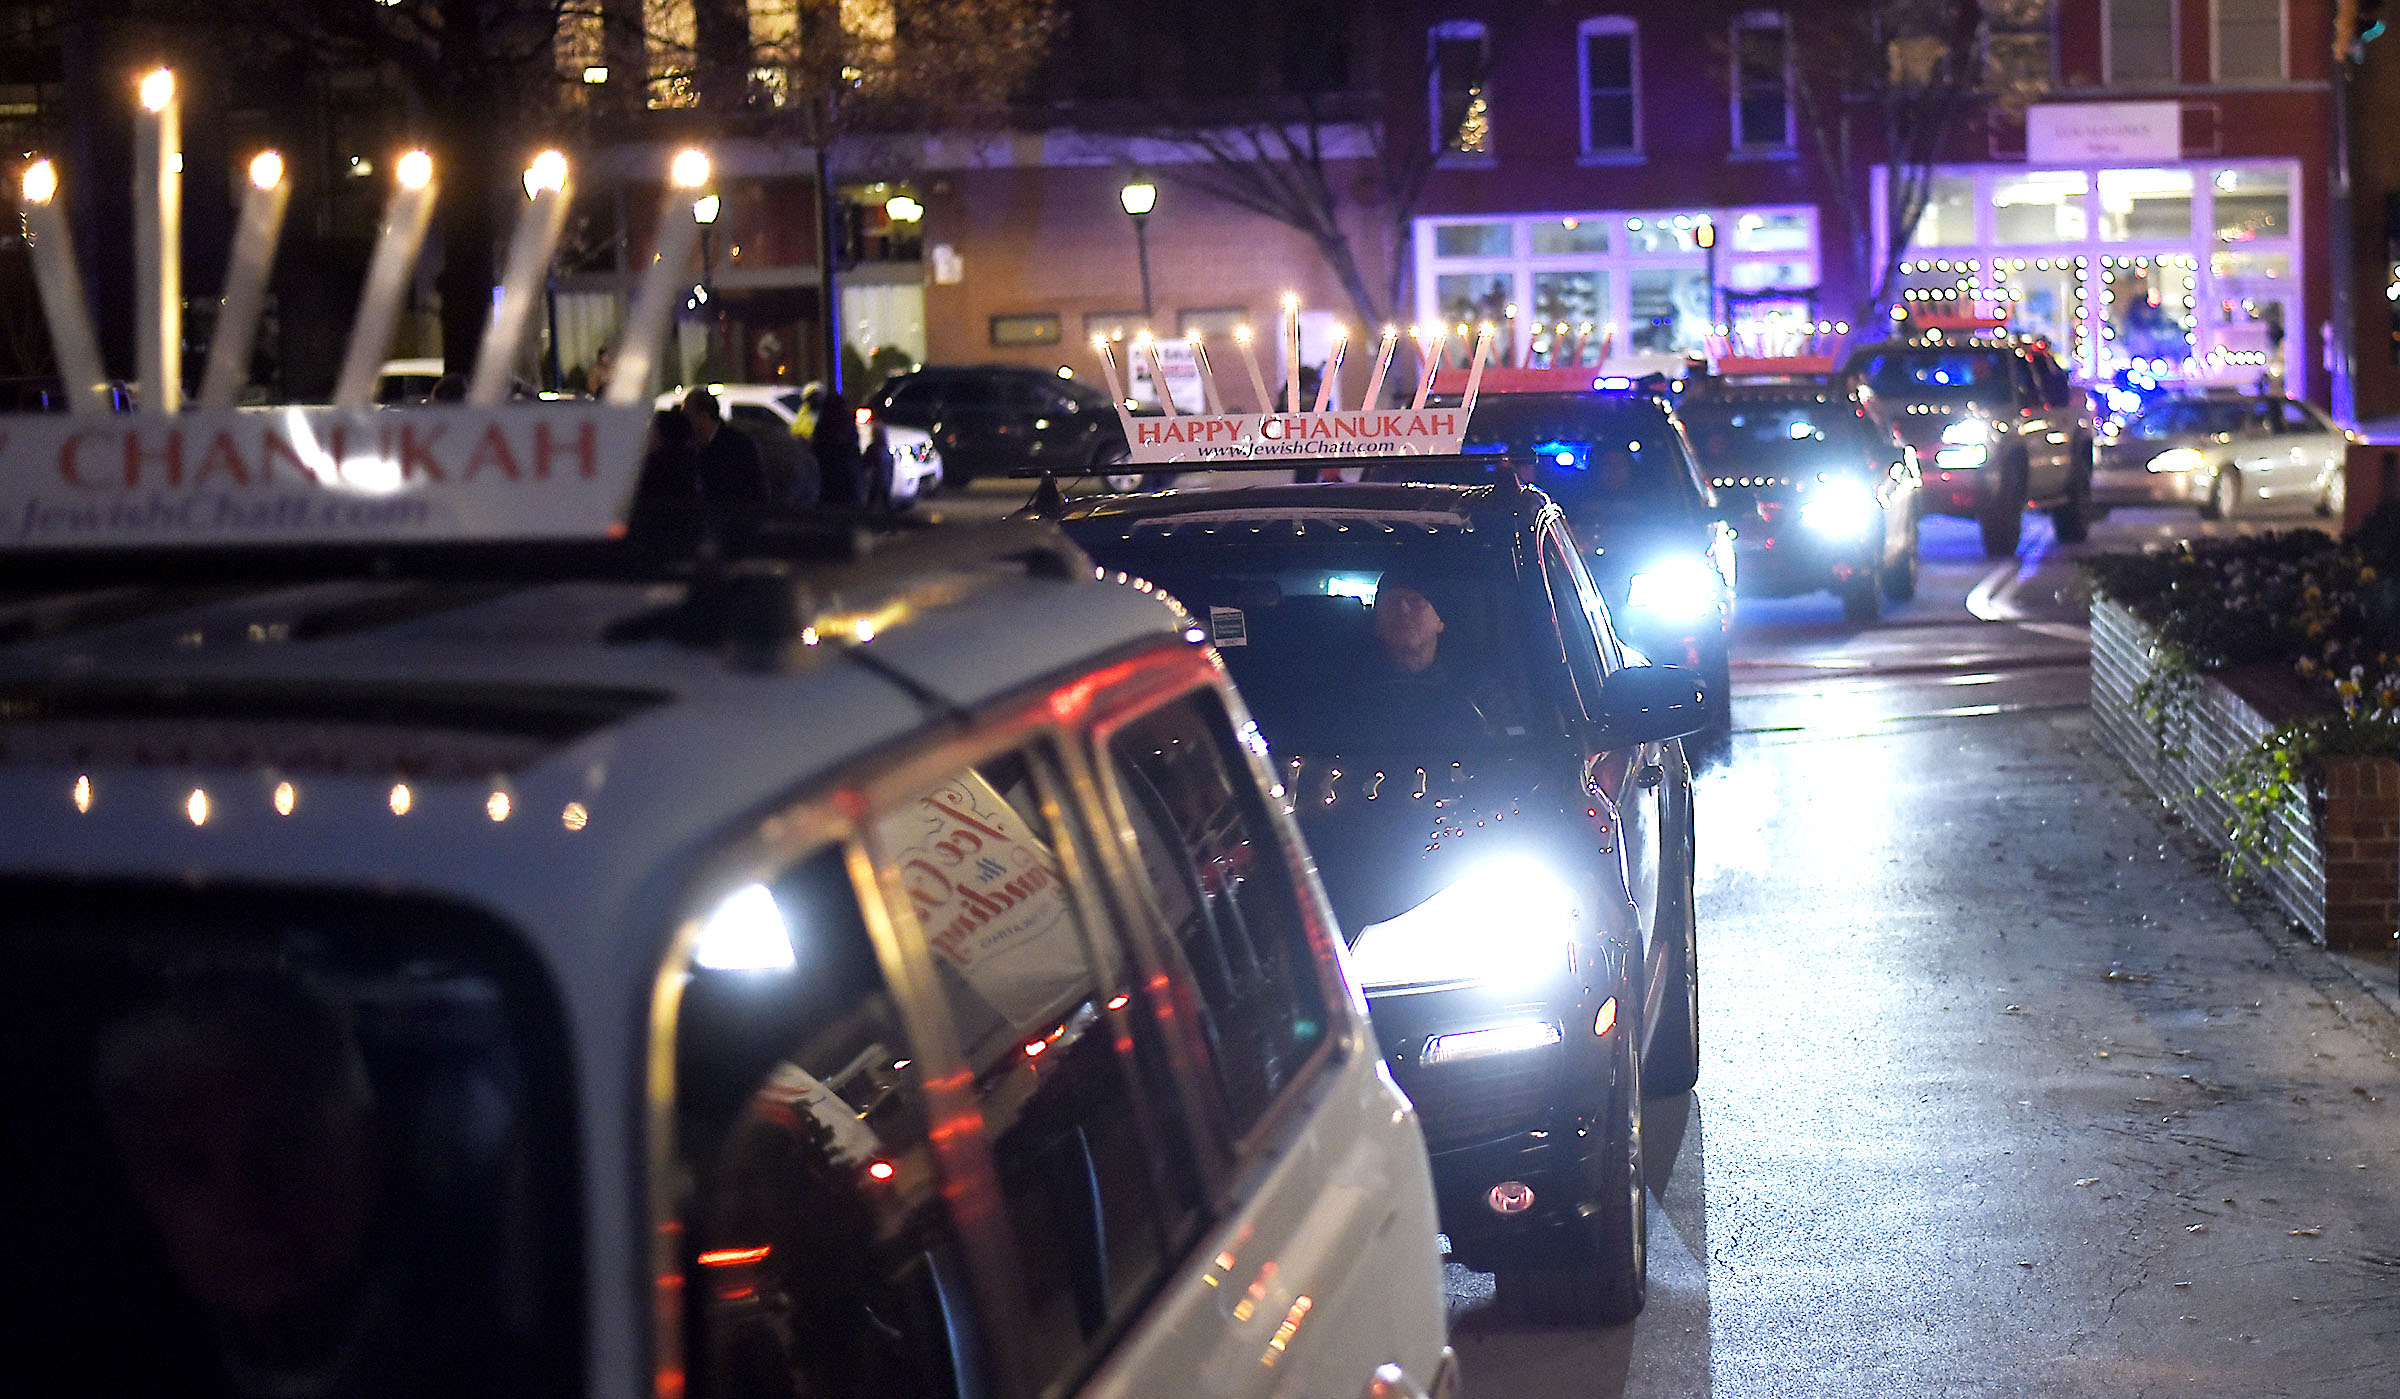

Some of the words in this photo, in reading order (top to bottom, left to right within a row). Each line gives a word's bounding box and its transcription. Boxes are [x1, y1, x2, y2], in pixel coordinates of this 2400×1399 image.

[1138, 420, 1243, 444] HAPPY
[1261, 414, 1455, 440] CHANUKAH
[57, 419, 599, 490] CHANUKAH
[1198, 441, 1395, 457] www.JewishChatt.com
